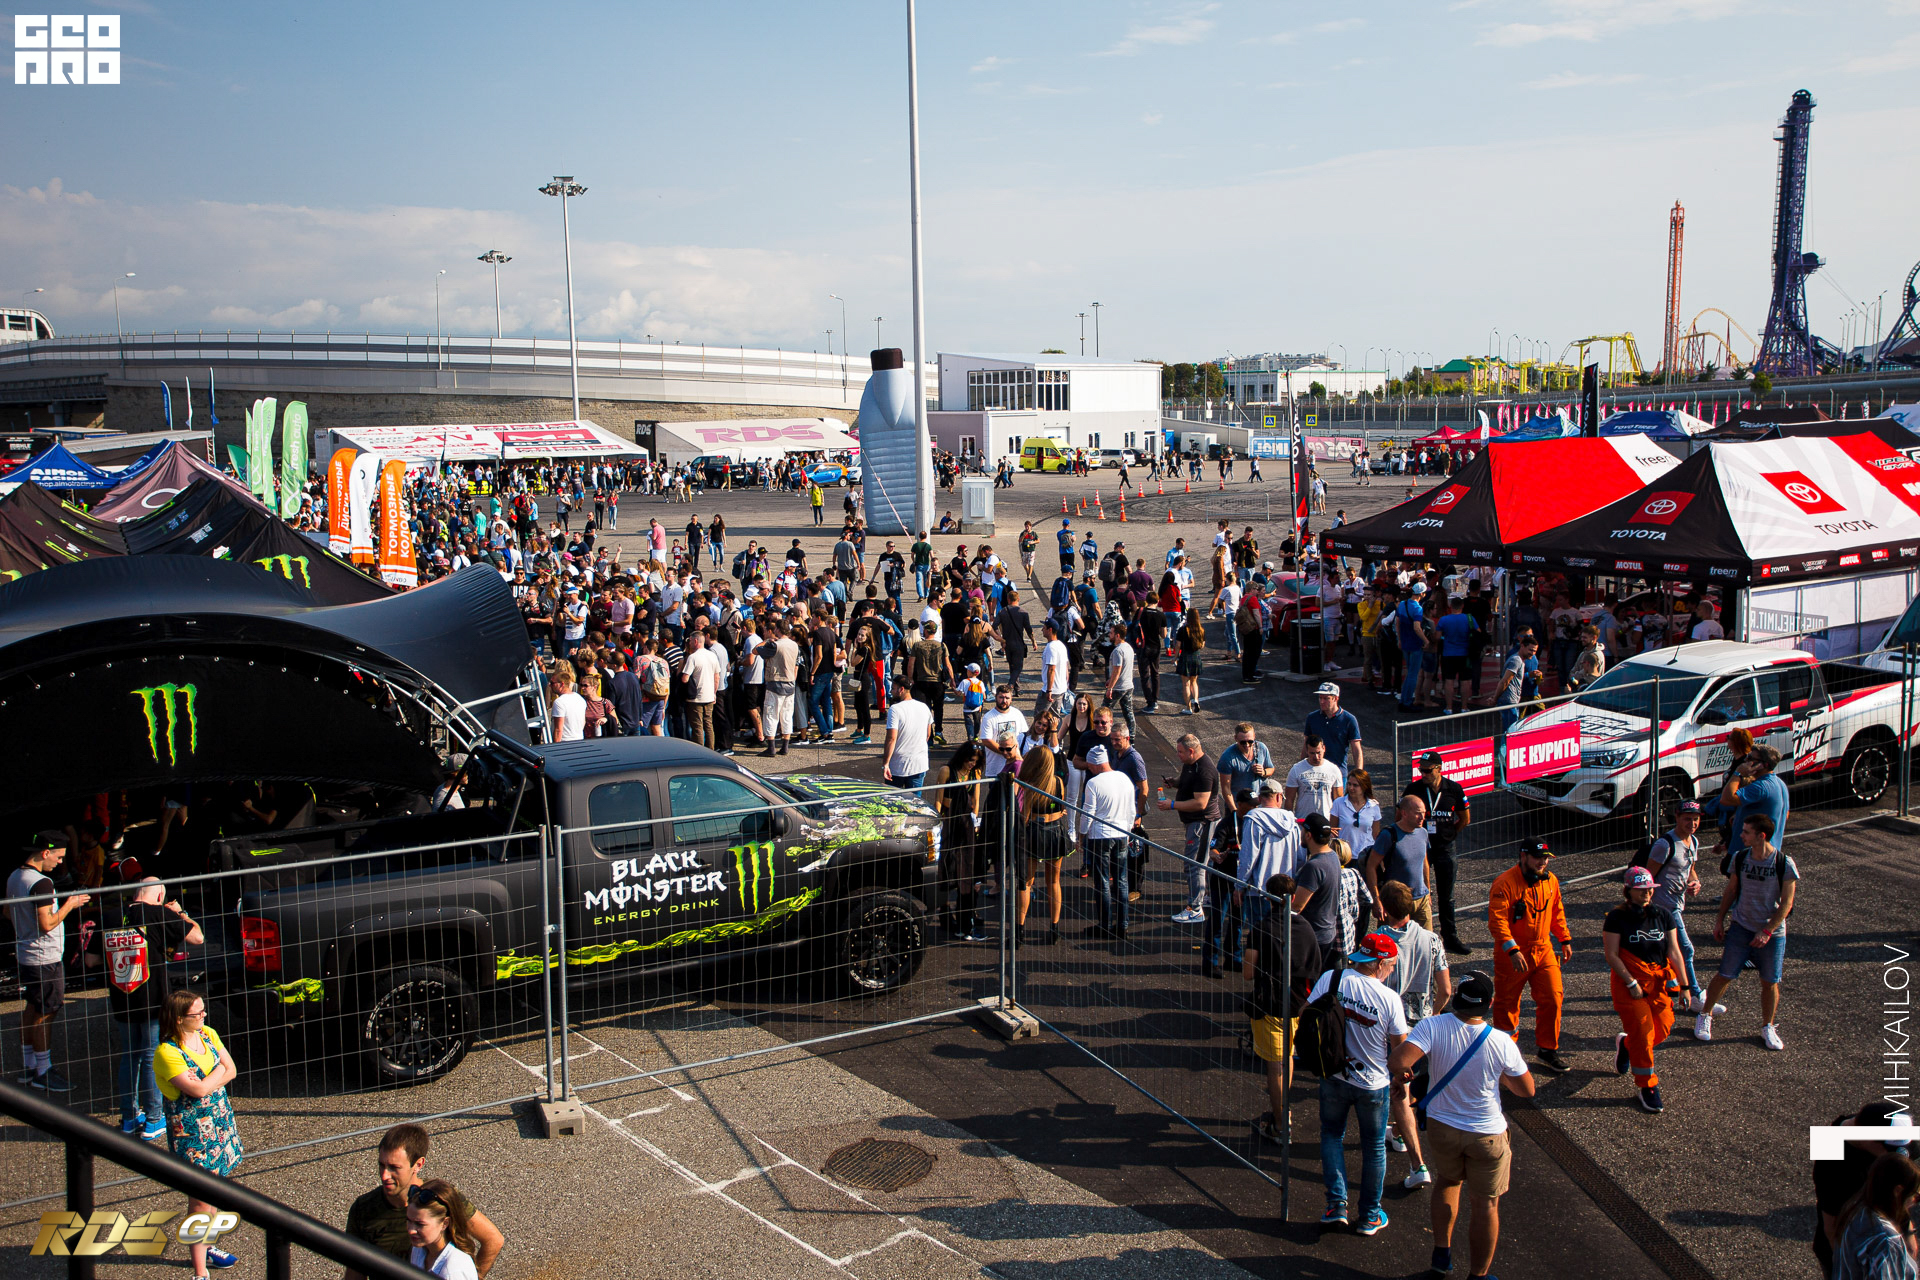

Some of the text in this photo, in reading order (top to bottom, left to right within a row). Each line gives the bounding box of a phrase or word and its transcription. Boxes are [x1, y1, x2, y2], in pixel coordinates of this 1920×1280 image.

[636, 423, 652, 435] RDS
[695, 424, 825, 443] RDS
[30, 468, 87, 477] AIMOL
[37, 480, 104, 488] hop.aimolracing.ru
[386, 473, 397, 557] ТОРМОЗНЫЕ
[1401, 518, 1444, 529] TOYOTA
[1814, 519, 1879, 536] TOYOTA
[1609, 529, 1667, 541] TOYOTA
[1403, 548, 1424, 556] MOTUL
[1523, 555, 1545, 563] TOYOTA
[1615, 561, 1642, 570] MOTUL
[1710, 566, 1738, 576] freem
[1770, 565, 1790, 574] TOYOTA
[511, 585, 529, 597] UCK
[1509, 737, 1580, 769] НЕ КУРИТЬ
[1459, 757, 1472, 769] ПРИ
[1472, 752, 1493, 766] ВХОДЕ
[1465, 765, 1492, 780] БРАСЛЕТ
[611, 850, 702, 883] BLACK
[584, 870, 728, 912] MONSTER
[594, 898, 720, 926] ENERGY DRINK
[1343, 996, 1378, 1016] yurich16
